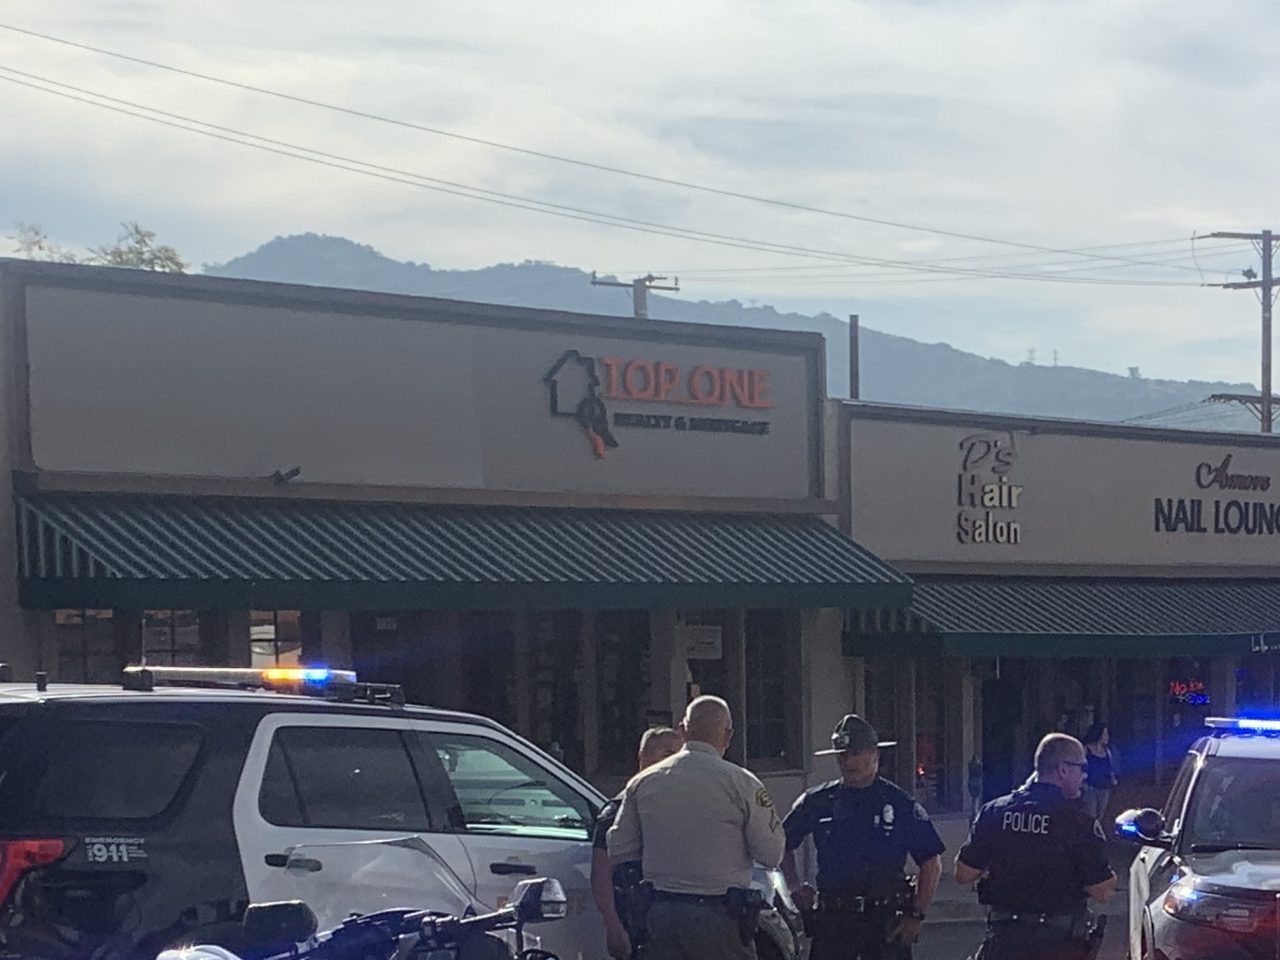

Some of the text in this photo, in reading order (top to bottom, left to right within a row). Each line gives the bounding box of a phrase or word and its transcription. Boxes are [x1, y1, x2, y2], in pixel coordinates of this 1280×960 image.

[601, 357, 773, 408] TOP ONE
[957, 473, 1024, 509] Hair
[956, 509, 1022, 545] Salon
[1154, 498, 1208, 535] NAIL
[1003, 811, 1049, 834] POLICE
